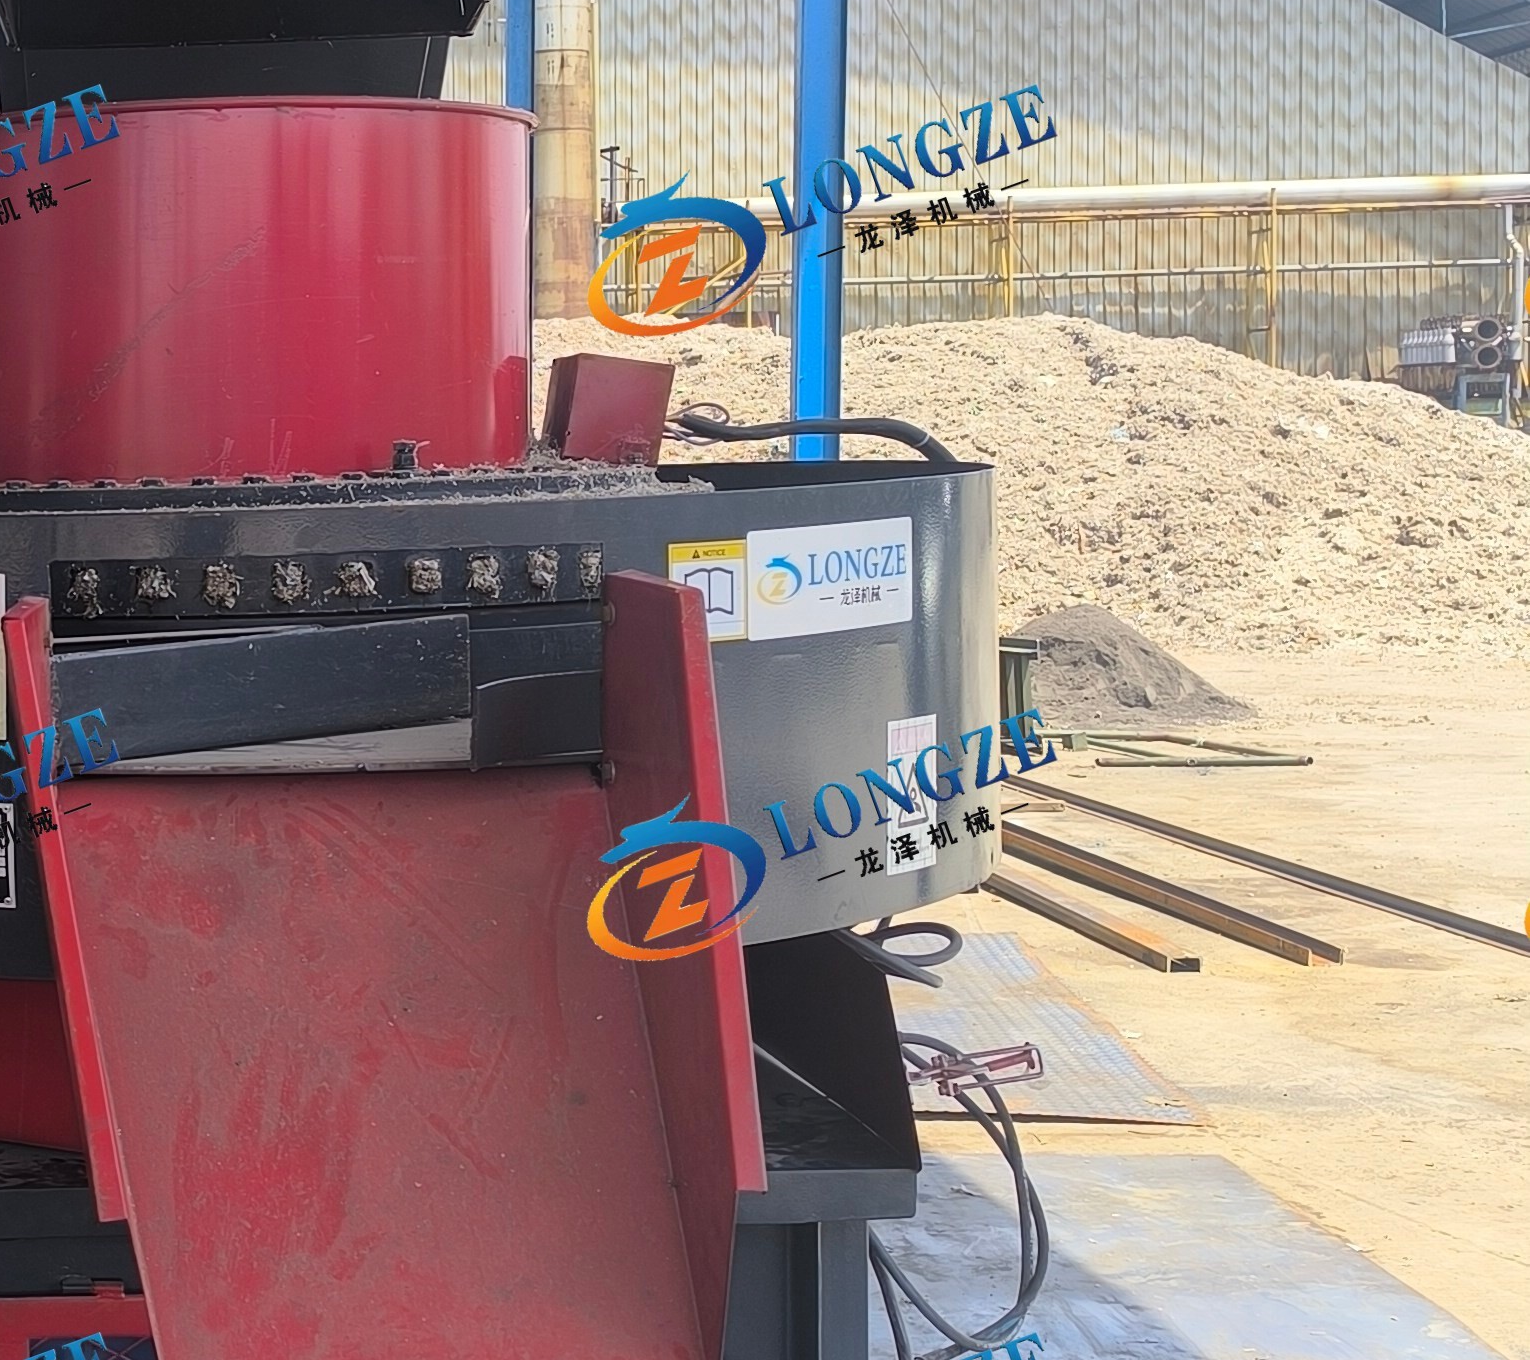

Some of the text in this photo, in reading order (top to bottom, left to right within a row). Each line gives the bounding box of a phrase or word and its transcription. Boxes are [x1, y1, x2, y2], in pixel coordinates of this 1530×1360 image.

[702, 548, 726, 558] NOTICE
[807, 543, 907, 586] LONGZE
[840, 584, 882, 606] 龙泽机械
